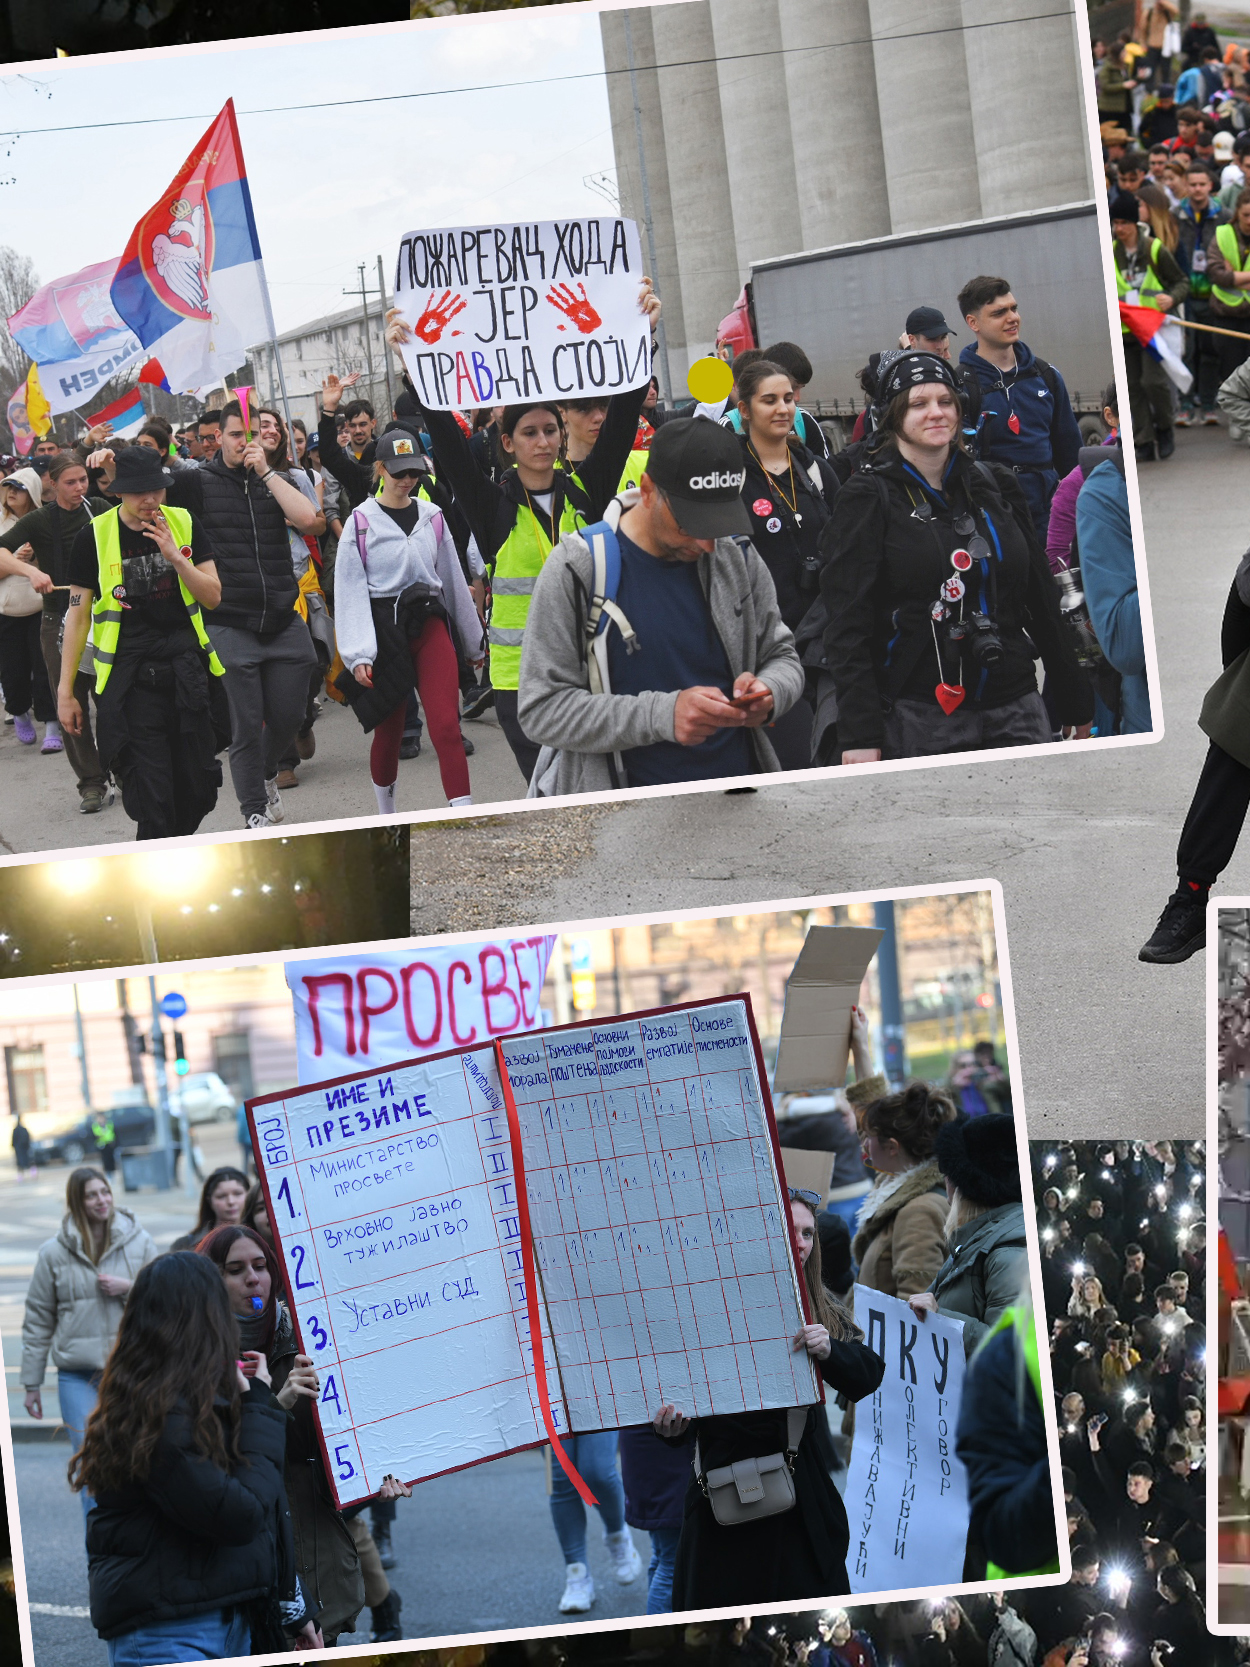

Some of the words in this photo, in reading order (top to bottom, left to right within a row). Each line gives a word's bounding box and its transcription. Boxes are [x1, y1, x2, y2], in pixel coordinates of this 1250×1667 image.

[396, 224, 546, 291] ПОЖАРЕВАЦ
[552, 220, 629, 279] ХОДА
[473, 284, 538, 343] ЈЕР
[416, 346, 542, 405] ПРАВДА
[553, 335, 648, 392] СТОЈИ
[689, 470, 742, 490] adidas
[503, 1050, 539, 1067] азвој
[325, 1082, 370, 1112] ИМЕ
[378, 1077, 395, 1097] И
[258, 1118, 289, 1165] БРОЈ
[306, 1094, 432, 1148] ПРЕЗИМЕ
[309, 1133, 440, 1182] Министарство
[334, 1160, 417, 1198] просвете
[277, 1176, 302, 1219] 1.
[323, 1215, 395, 1249] Врховно
[409, 1198, 463, 1224] јавно
[343, 1218, 469, 1265] тужилаштво
[290, 1245, 320, 1290] 2.
[307, 1315, 332, 1351] 3.
[342, 1290, 432, 1333] Уставни
[321, 1374, 347, 1415] 4.
[334, 1444, 358, 1481] 5.
